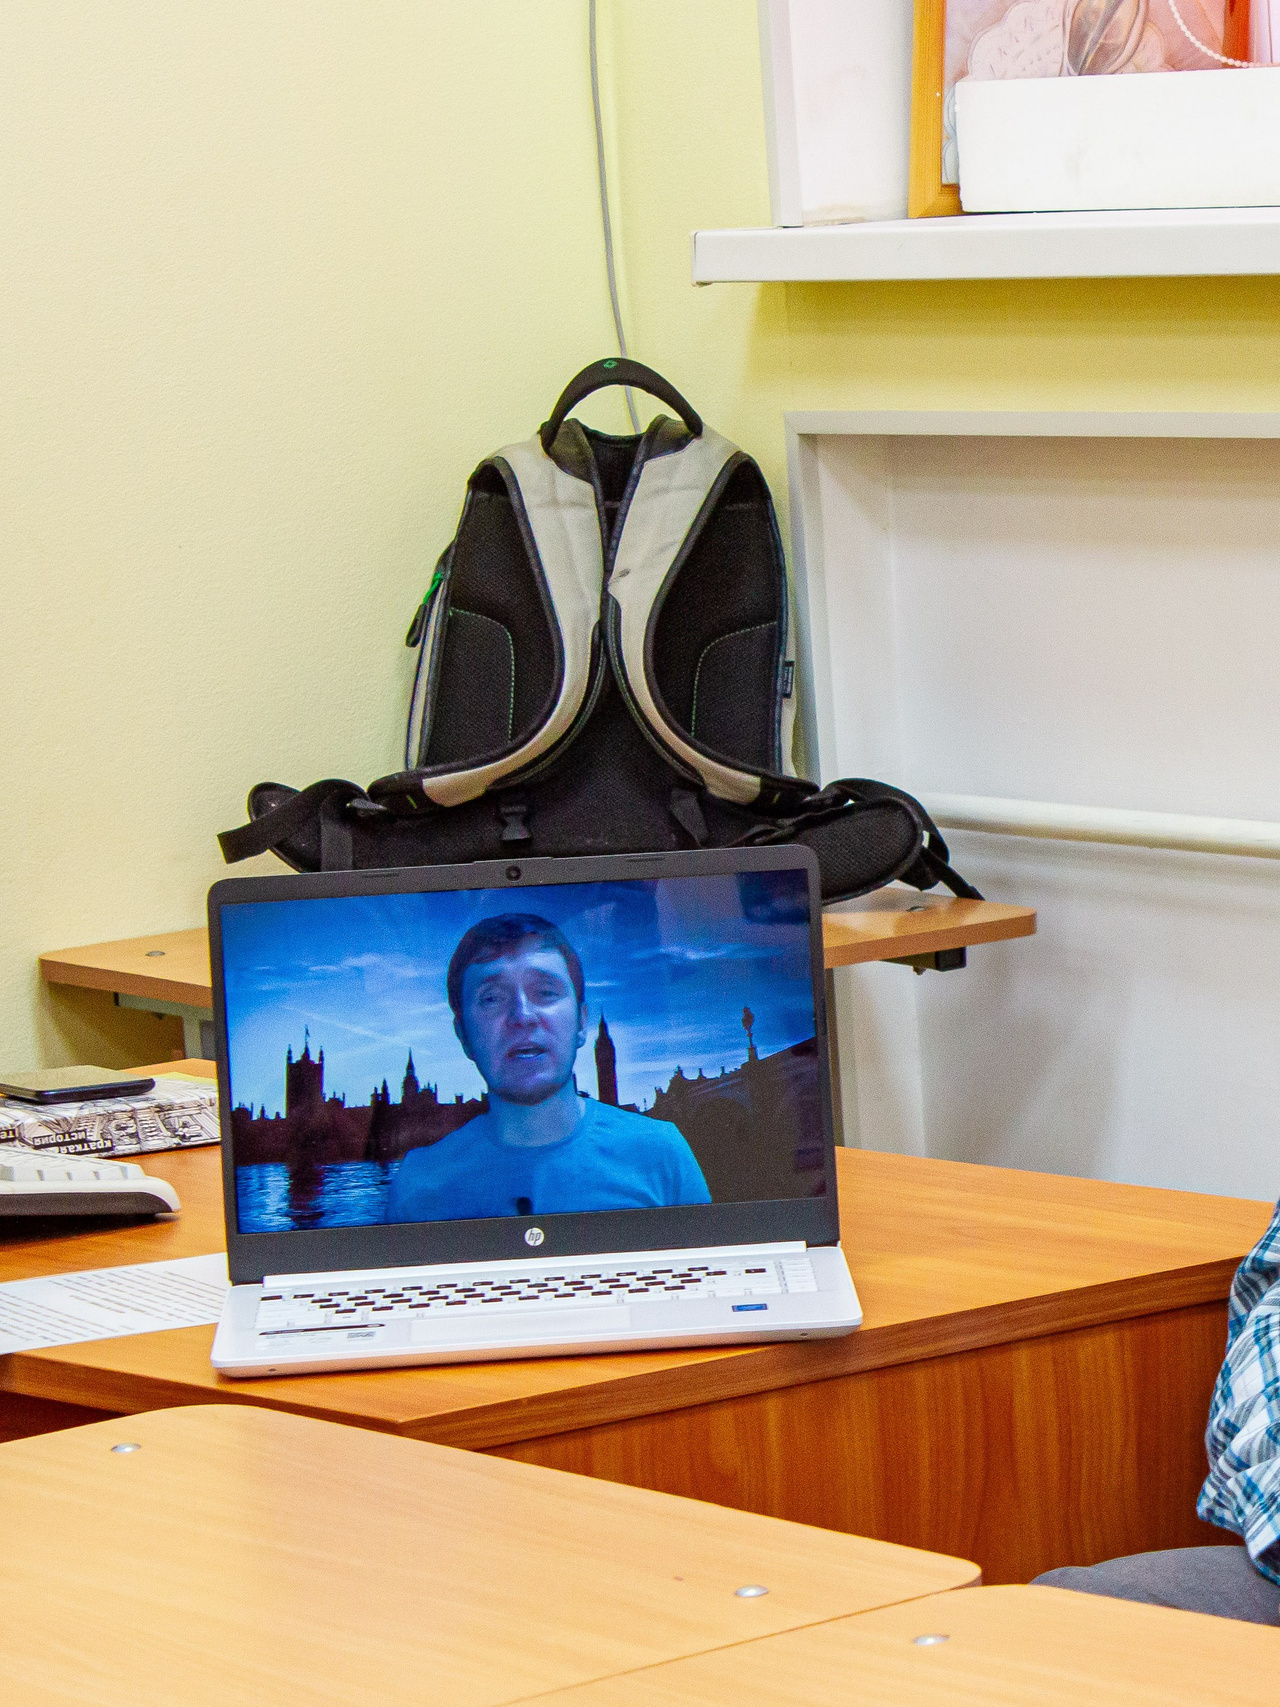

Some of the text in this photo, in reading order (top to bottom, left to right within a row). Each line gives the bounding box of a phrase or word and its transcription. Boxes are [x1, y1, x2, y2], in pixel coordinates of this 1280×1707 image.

[34, 1131, 86, 1146] история
[60, 1139, 112, 1154] краткая
[527, 1229, 542, 1246] hp
